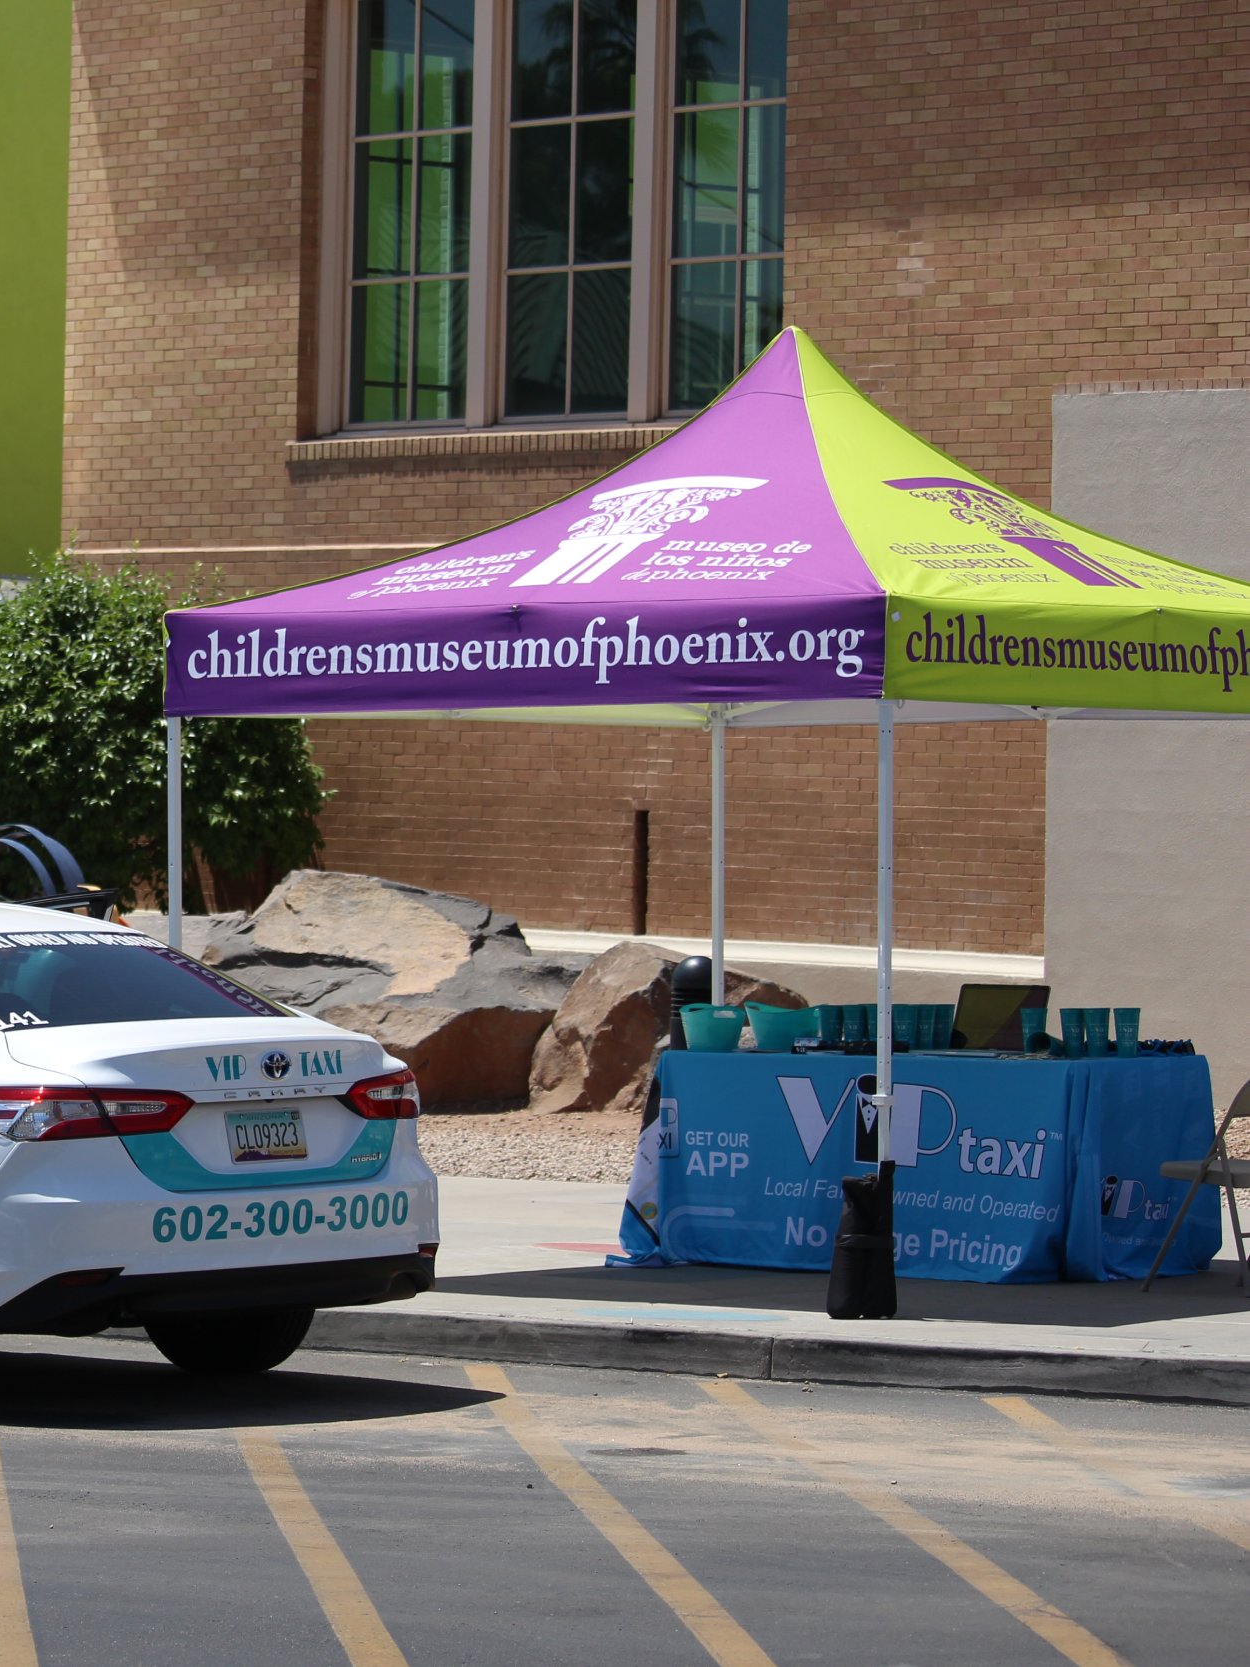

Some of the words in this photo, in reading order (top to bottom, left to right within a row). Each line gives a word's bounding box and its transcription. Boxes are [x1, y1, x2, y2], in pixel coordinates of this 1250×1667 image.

[660, 539, 767, 553] museo
[773, 540, 812, 554] de
[640, 552, 695, 566] los
[696, 554, 793, 567] niños
[911, 557, 1033, 570] museum
[371, 563, 516, 586] museum
[640, 567, 775, 583] phoenix
[370, 577, 498, 598] phoenix
[187, 616, 866, 685] childrensmuseumofphoenix.org
[7, 933, 69, 946] OWNED
[59, 932, 99, 945] AND
[205, 1054, 247, 1083] VIP
[298, 1049, 343, 1077] TAXI
[235, 1122, 299, 1150] CL09323
[685, 1130, 714, 1146] GET
[717, 1132, 749, 1148] OUR
[685, 1150, 749, 1178] APP
[958, 1127, 1046, 1179] taxi
[764, 1177, 809, 1198] Local
[892, 1190, 940, 1209] wned
[942, 1193, 976, 1213] and
[980, 1194, 1061, 1223] Operated
[152, 1190, 409, 1243] 602-300-3000
[785, 1216, 827, 1247] No
[929, 1228, 1023, 1272] Pricing
